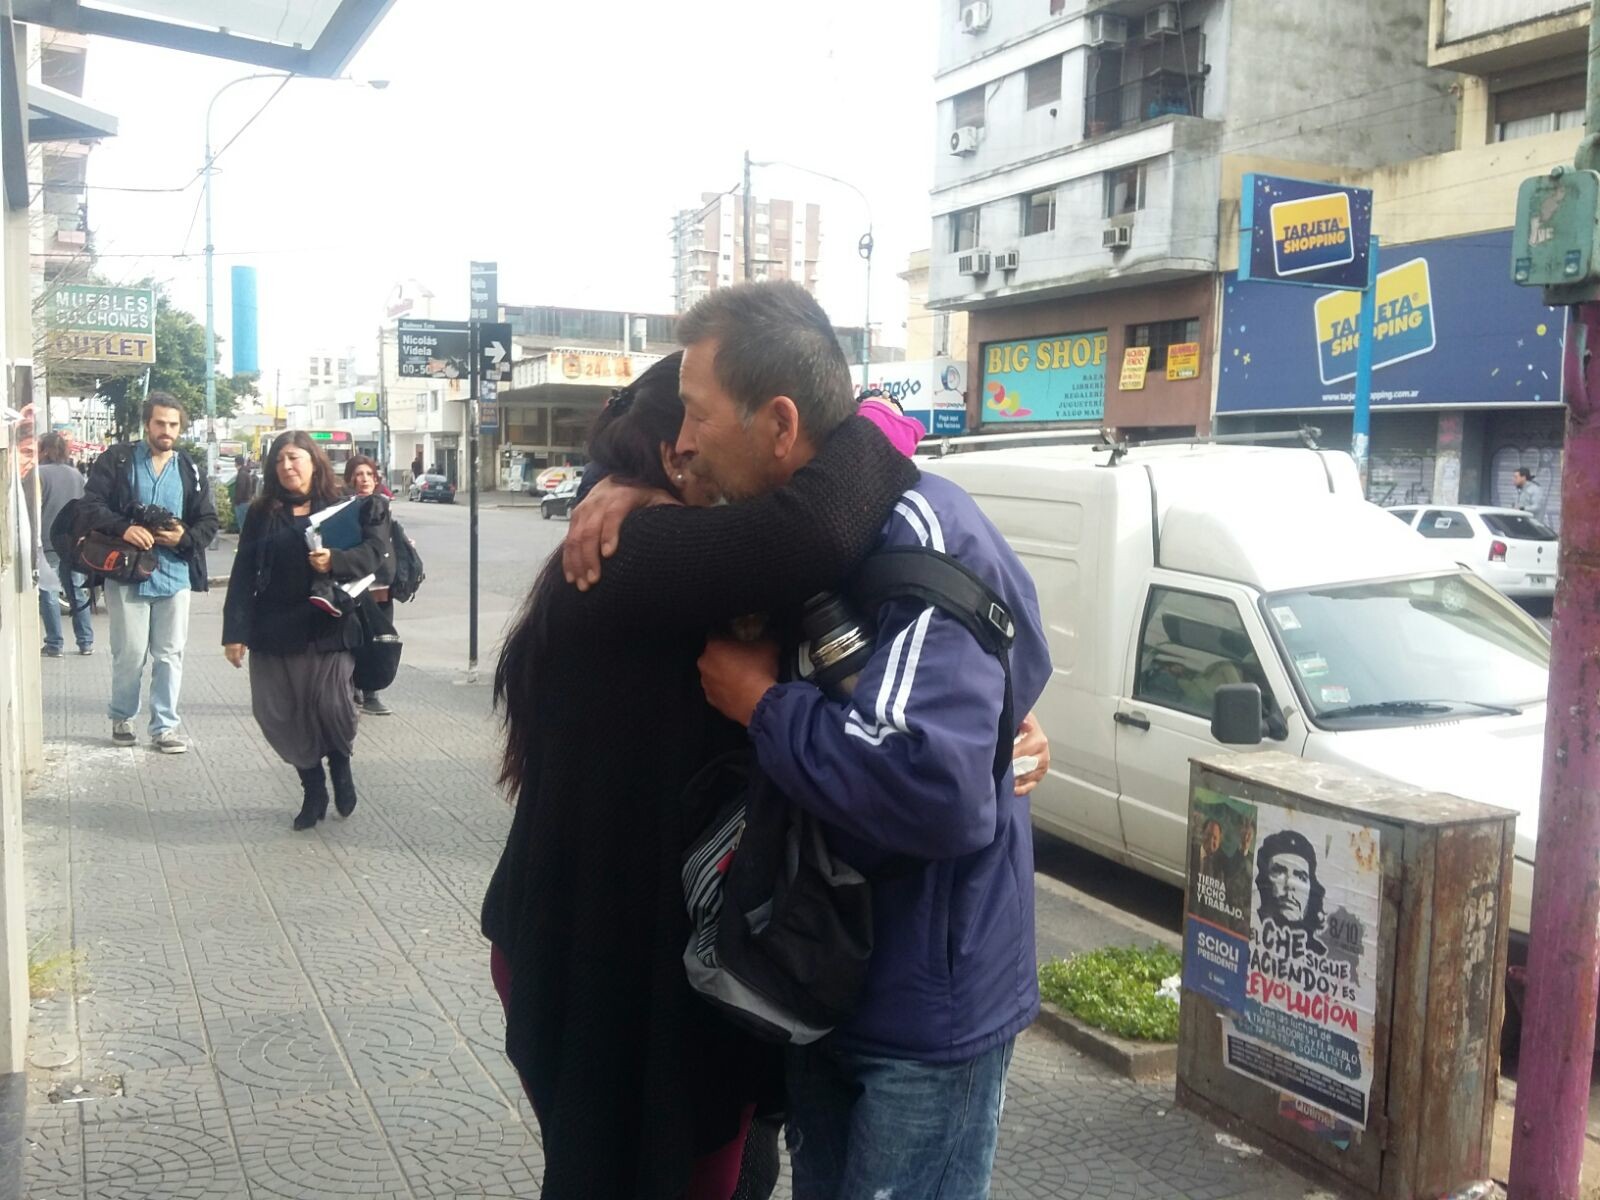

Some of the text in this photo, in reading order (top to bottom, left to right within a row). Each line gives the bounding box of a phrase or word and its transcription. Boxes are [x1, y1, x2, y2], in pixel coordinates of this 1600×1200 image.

[1283, 217, 1340, 243] TARJETA
[1283, 230, 1345, 254] SHOPPING
[56, 291, 148, 313] MUEBLES
[56, 309, 149, 328] COLCHONES
[1331, 294, 1413, 339] TAETA
[56, 336, 148, 357] OUTLET
[1331, 310, 1423, 356] SHOPING
[402, 345, 432, 356] Videla
[988, 336, 1107, 373] BIG SHOP
[1197, 882, 1226, 901] TECHO
[1198, 873, 1226, 892] TIERRA
[1197, 893, 1245, 920] Y TRABAJO.
[1262, 920, 1306, 960] CHE
[1329, 917, 1359, 945] 8/10
[1197, 931, 1239, 962] SCIOLI
[1197, 946, 1238, 974] PRESIDENTE
[1250, 948, 1330, 994] ACIENDO
[1342, 985, 1356, 1001] ES
[1306, 953, 1348, 979] SIGUE
[1246, 971, 1358, 1033] EVOLUCIÓN
[1260, 1004, 1276, 1019] Con
[1290, 1016, 1319, 1036] luchas
[1320, 1029, 1332, 1042] de
[1299, 1044, 1352, 1073] SOCIALISTA
